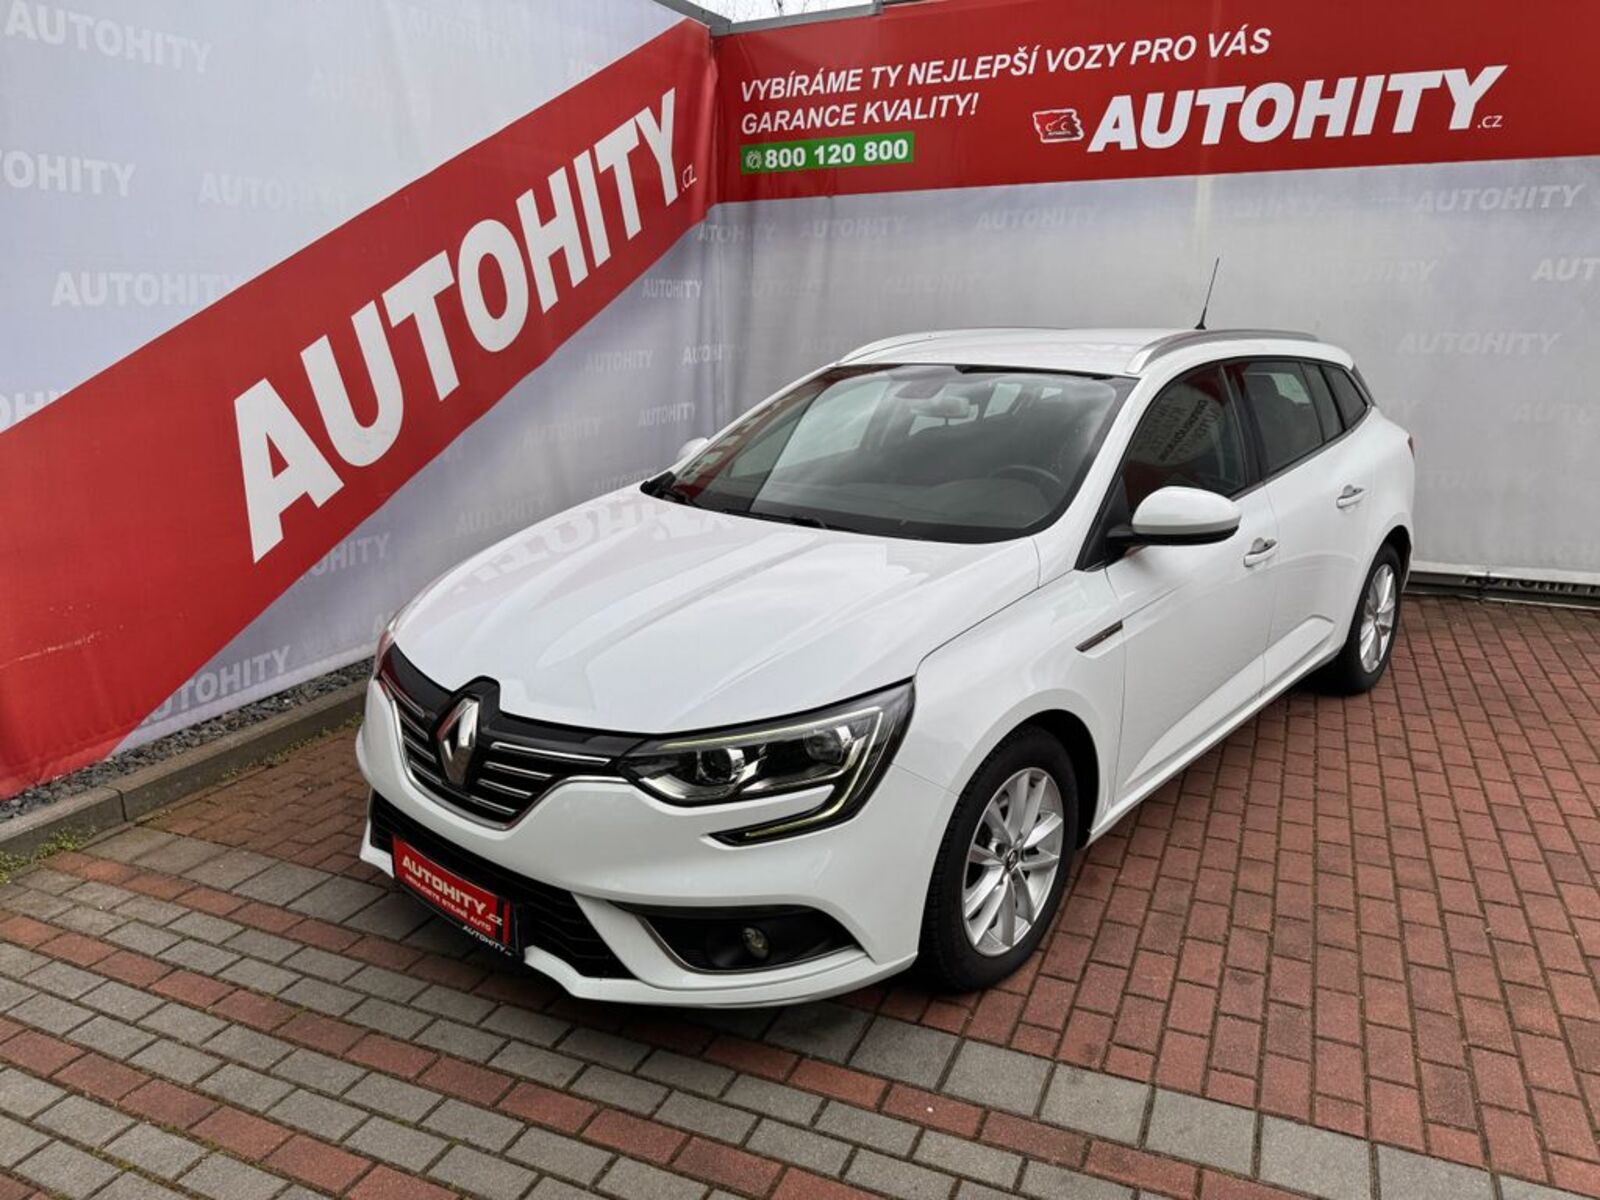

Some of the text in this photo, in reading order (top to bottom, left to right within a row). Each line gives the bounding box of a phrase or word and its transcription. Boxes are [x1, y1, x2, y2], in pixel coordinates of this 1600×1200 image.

[5, 0, 213, 74] AUTOHITY
[741, 24, 1272, 102] VYBÍRÁME TY NEJLEPŠÍ VOZY PRO VÁS
[741, 93, 980, 135] GARANCE KVALITY!
[765, 139, 909, 169] 800 120 800
[0, 151, 136, 197] OHITY
[1411, 184, 1586, 213] AUTOHITY
[641, 278, 704, 299] AUTOHITY
[1397, 331, 1563, 356] AUTOHITY
